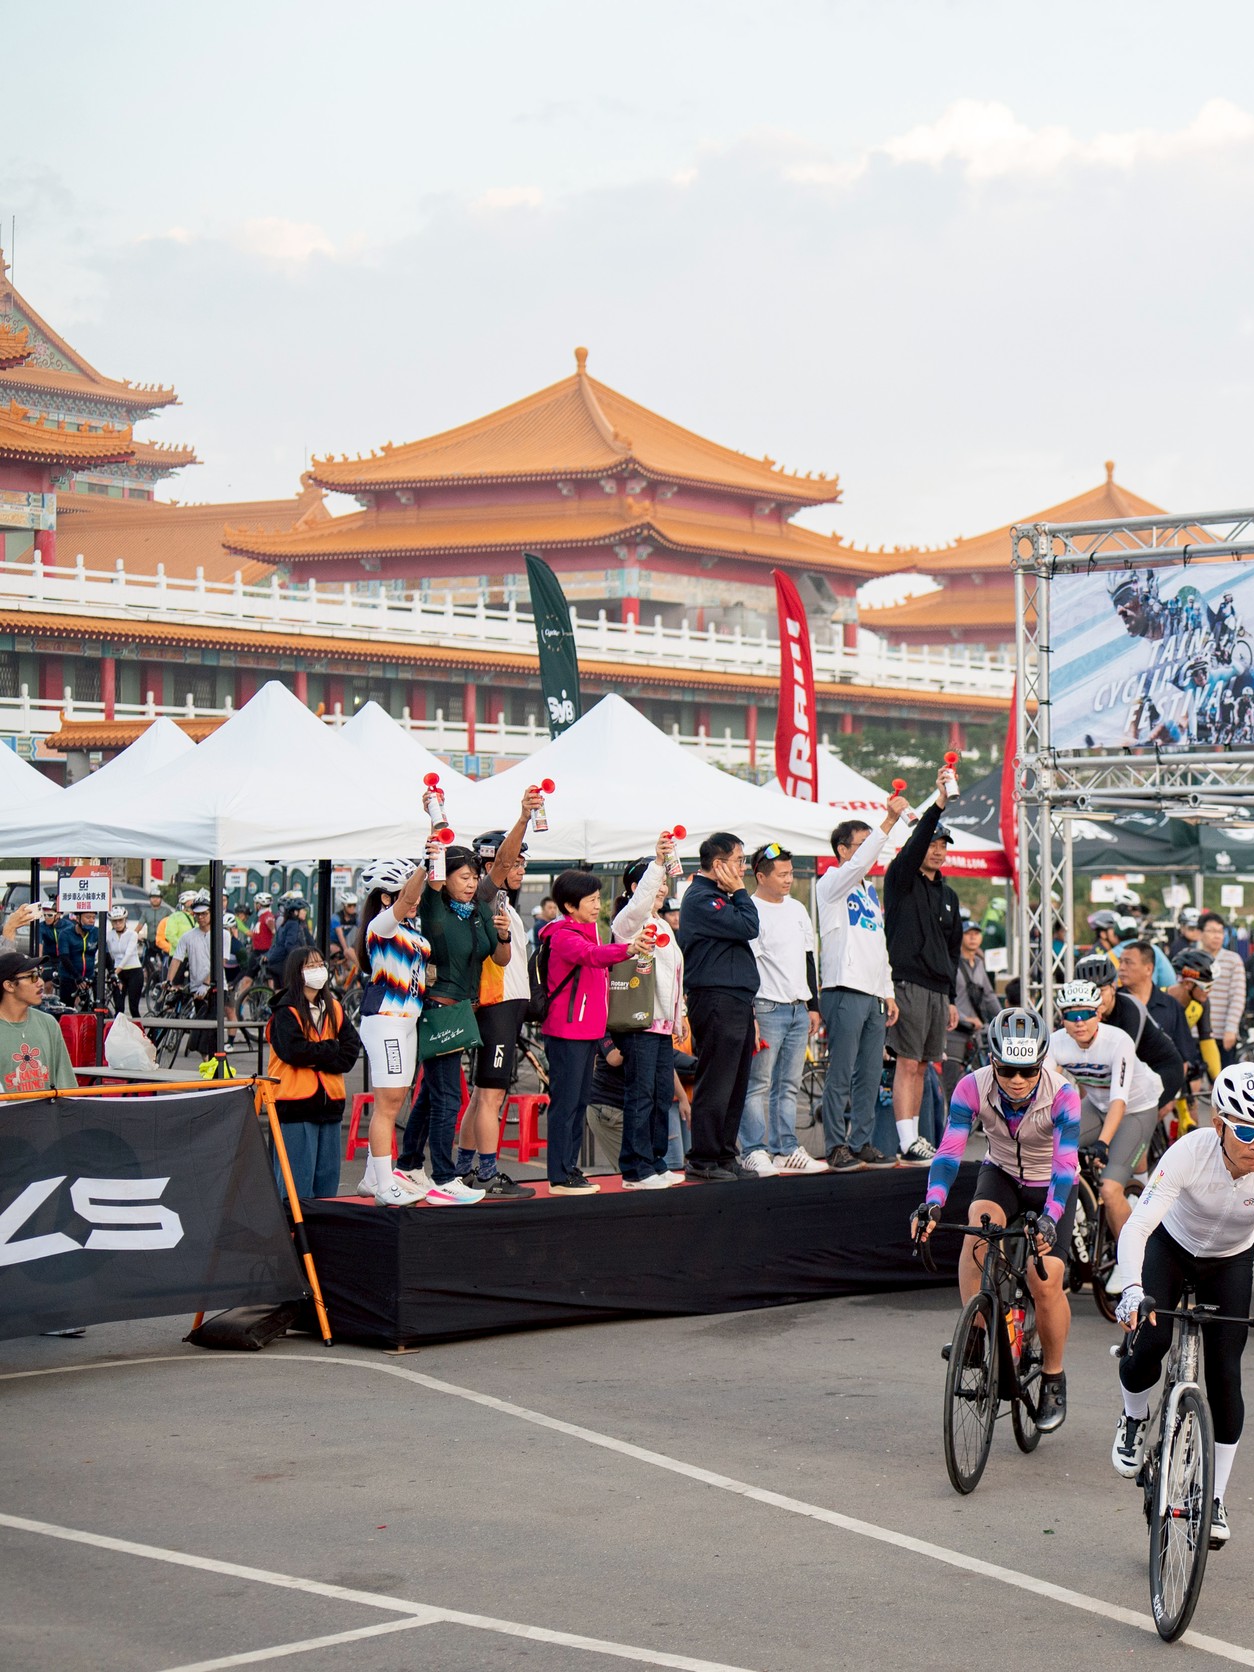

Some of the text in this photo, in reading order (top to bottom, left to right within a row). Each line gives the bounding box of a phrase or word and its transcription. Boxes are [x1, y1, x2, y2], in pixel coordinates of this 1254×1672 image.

[610, 980, 629, 988] Rotary
[1067, 986, 1089, 995] 0002
[493, 1044, 505, 1069] KS
[1006, 1046, 1034, 1057] 0009
